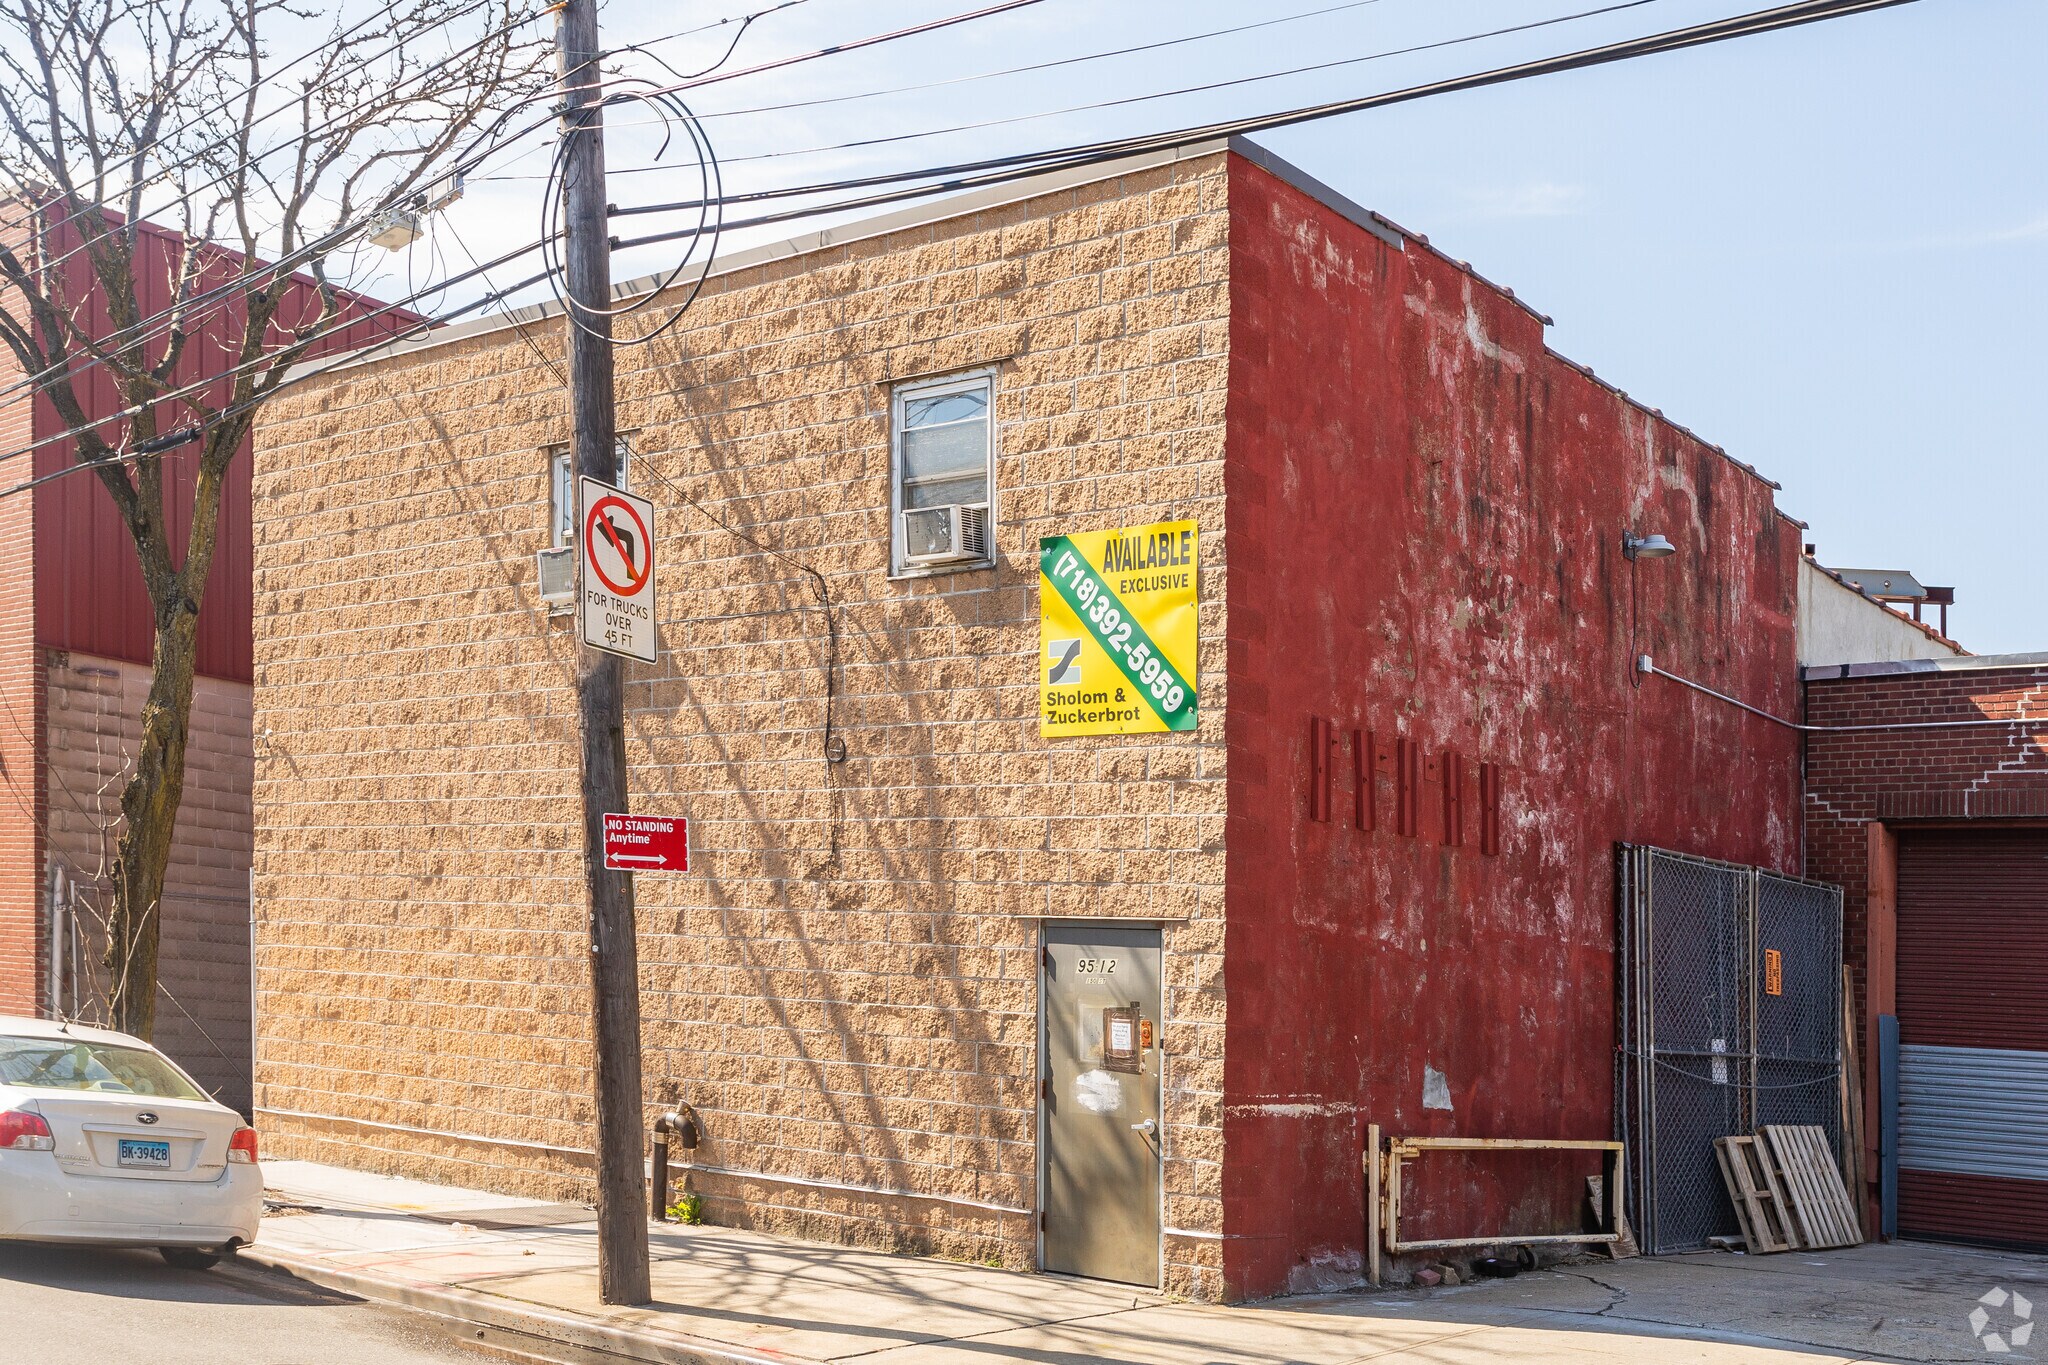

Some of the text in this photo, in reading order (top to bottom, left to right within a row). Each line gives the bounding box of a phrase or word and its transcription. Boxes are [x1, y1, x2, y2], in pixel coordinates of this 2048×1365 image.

[1103, 530, 1191, 573] AVAILABLE
[1120, 573, 1189, 594] EXCLUSIVE
[587, 590, 648, 620] FOR TRUCKS
[605, 612, 632, 631] OVER
[604, 629, 633, 648] 45 FT
[1053, 550, 1184, 713] (718)392-5959
[1047, 687, 1126, 706] Sholom &
[1047, 706, 1140, 725] Zuckerbrot
[608, 820, 674, 833] NO STANDING
[609, 832, 650, 845] Anytime
